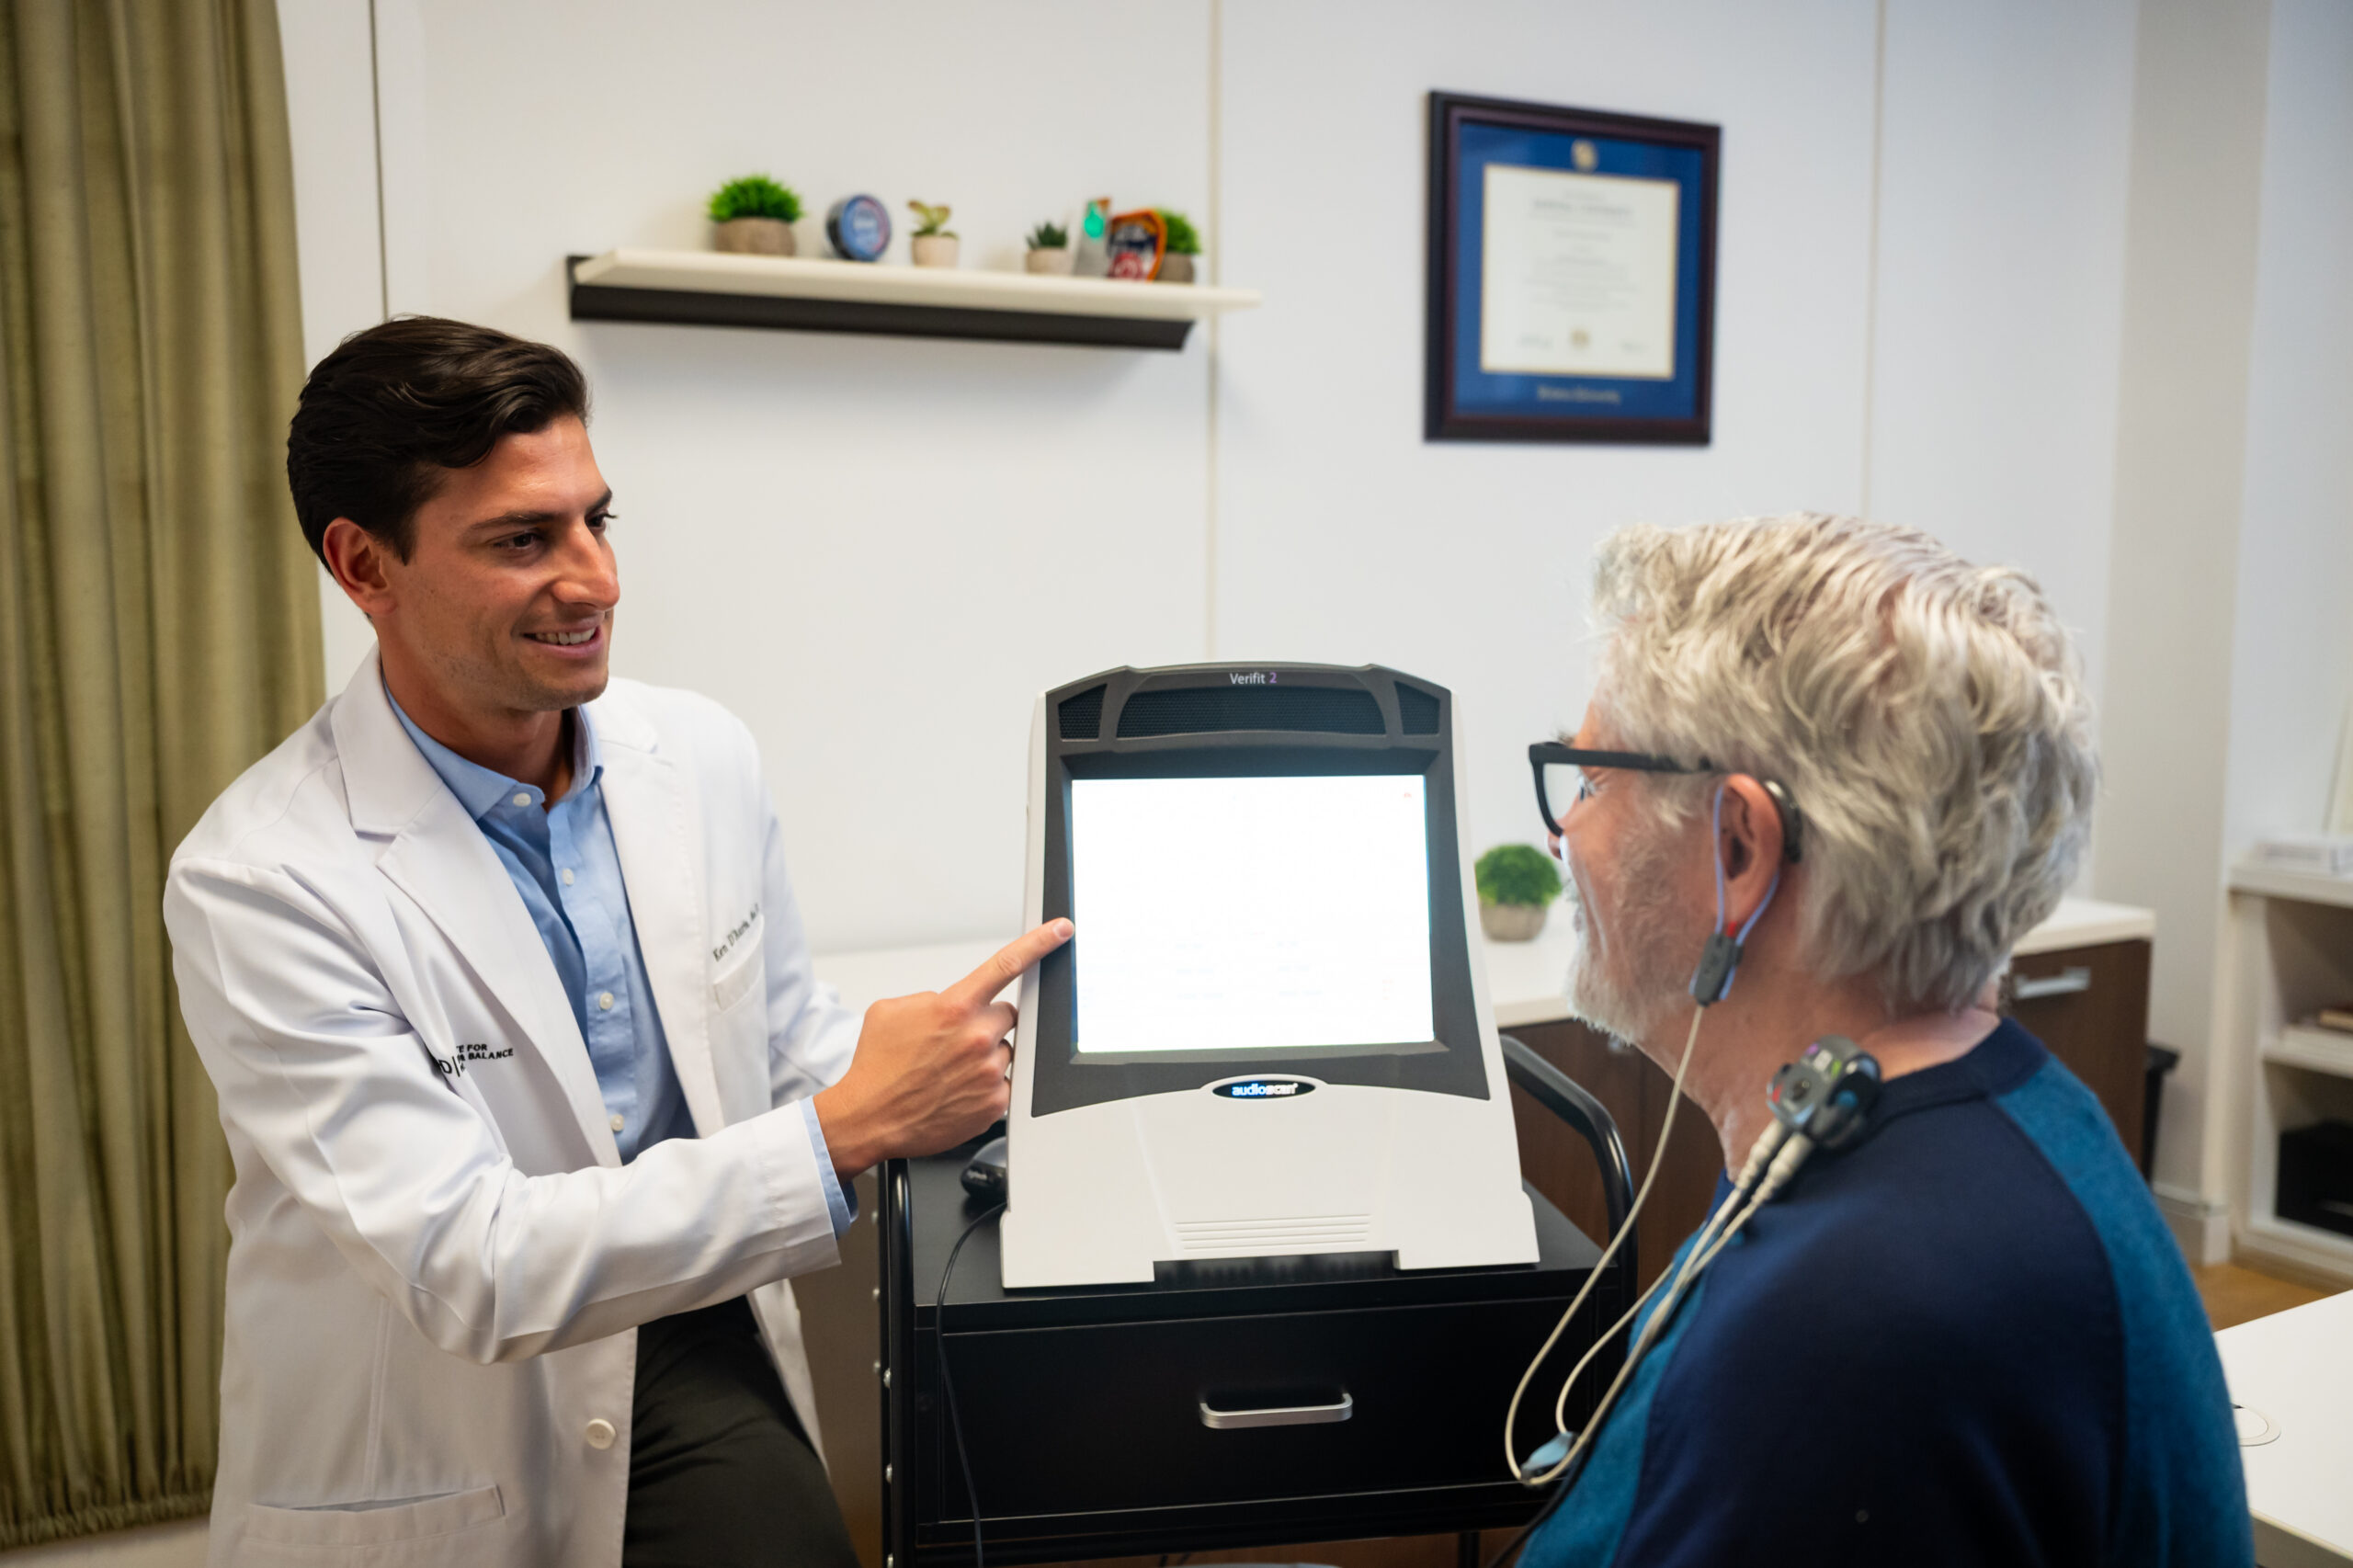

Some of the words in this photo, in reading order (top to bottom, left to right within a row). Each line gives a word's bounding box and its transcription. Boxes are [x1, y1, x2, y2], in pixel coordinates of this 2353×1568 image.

[1229, 672, 1266, 685] Verifit
[1269, 672, 1278, 684] 2
[467, 1043, 487, 1051] FOR
[468, 1048, 514, 1060] BALANCE
[1232, 1083, 1296, 1096] audioscan
